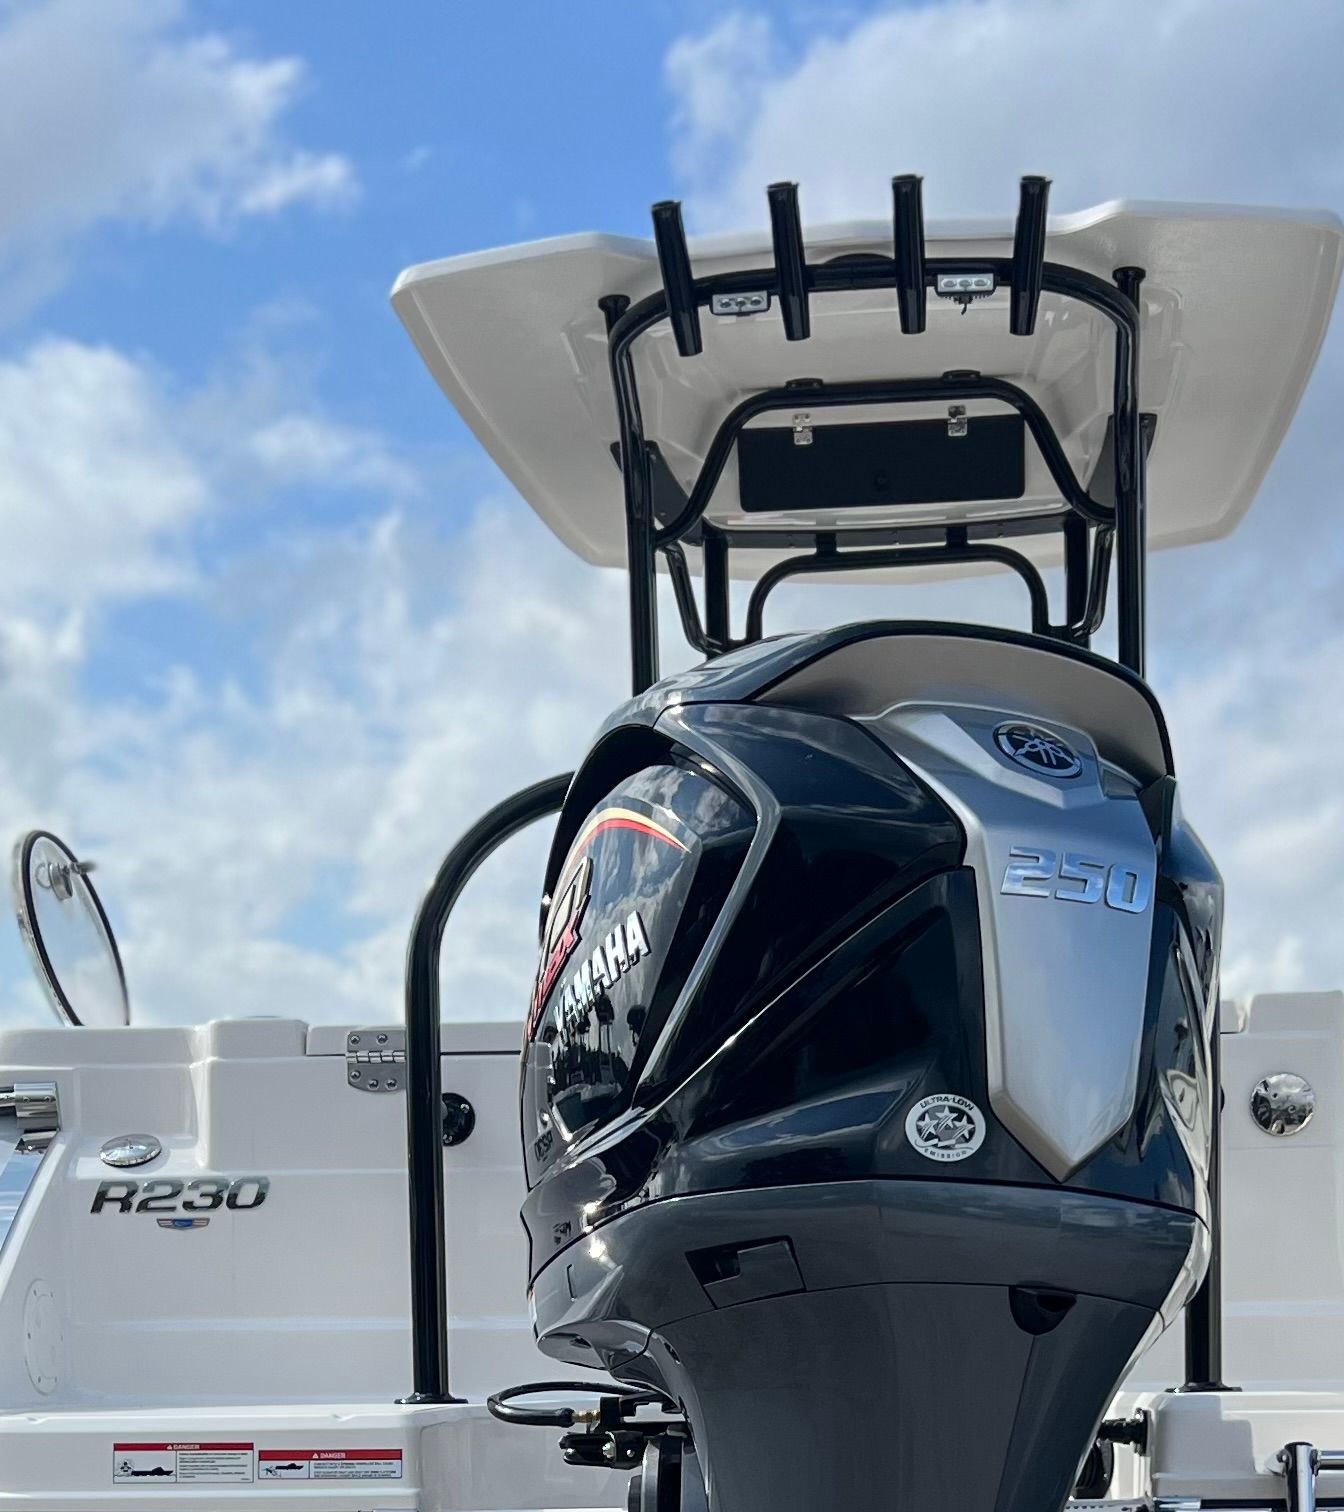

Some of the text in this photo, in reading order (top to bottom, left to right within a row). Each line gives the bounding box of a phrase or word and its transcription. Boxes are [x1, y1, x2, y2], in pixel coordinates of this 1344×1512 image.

[1001, 846, 1152, 914] 250
[553, 909, 652, 1047] YAMAHA
[920, 1095, 975, 1111] ULTRA-LOW
[90, 1175, 271, 1214] R230
